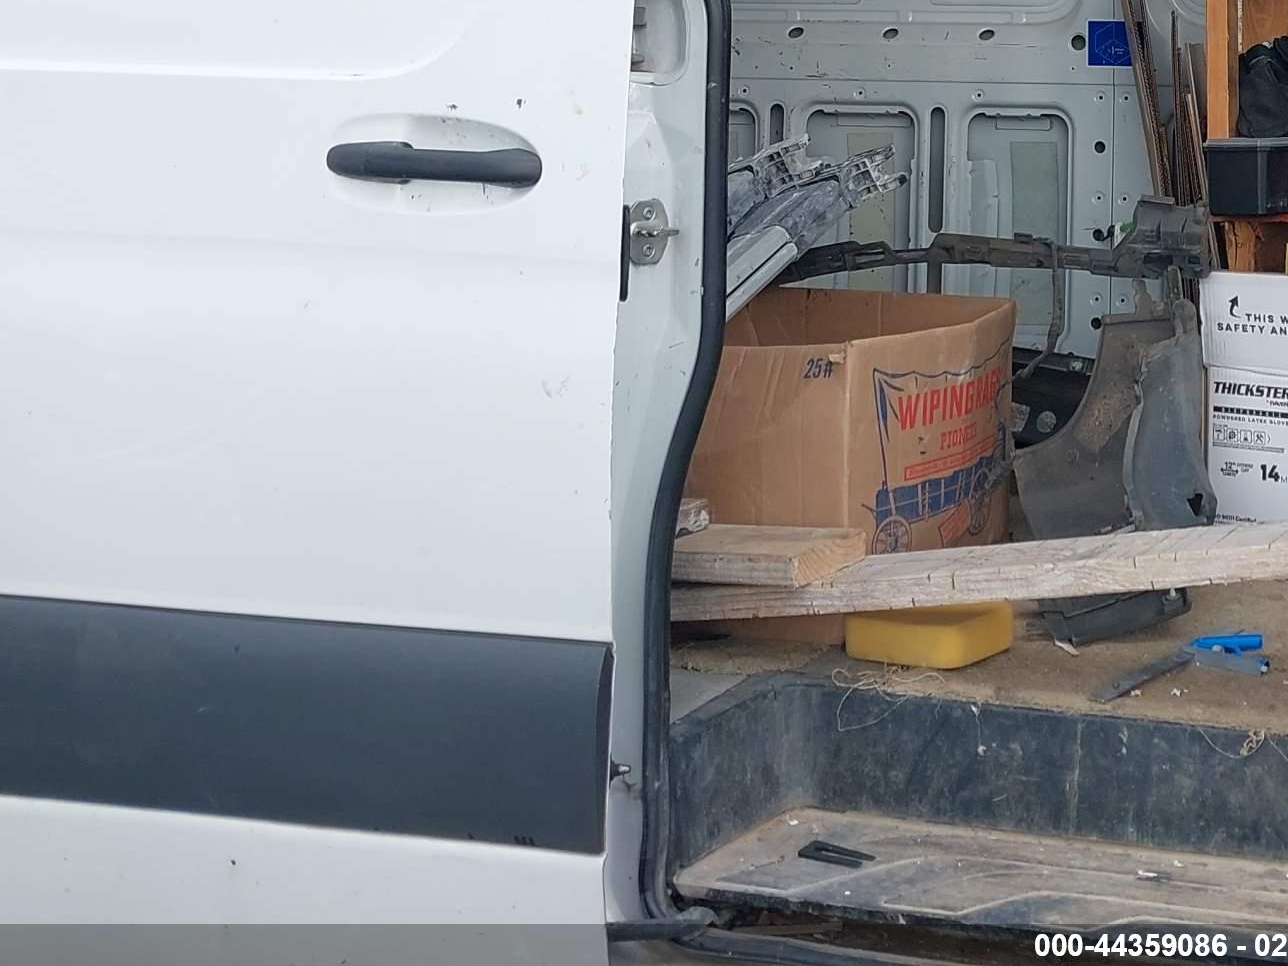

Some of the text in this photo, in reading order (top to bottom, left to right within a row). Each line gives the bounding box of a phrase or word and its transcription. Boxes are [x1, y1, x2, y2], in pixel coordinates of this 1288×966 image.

[1245, 313, 1274, 323] THIS
[1217, 322, 1265, 334] SAFETY
[898, 380, 975, 431] WIPING
[1260, 464, 1280, 483] 14
